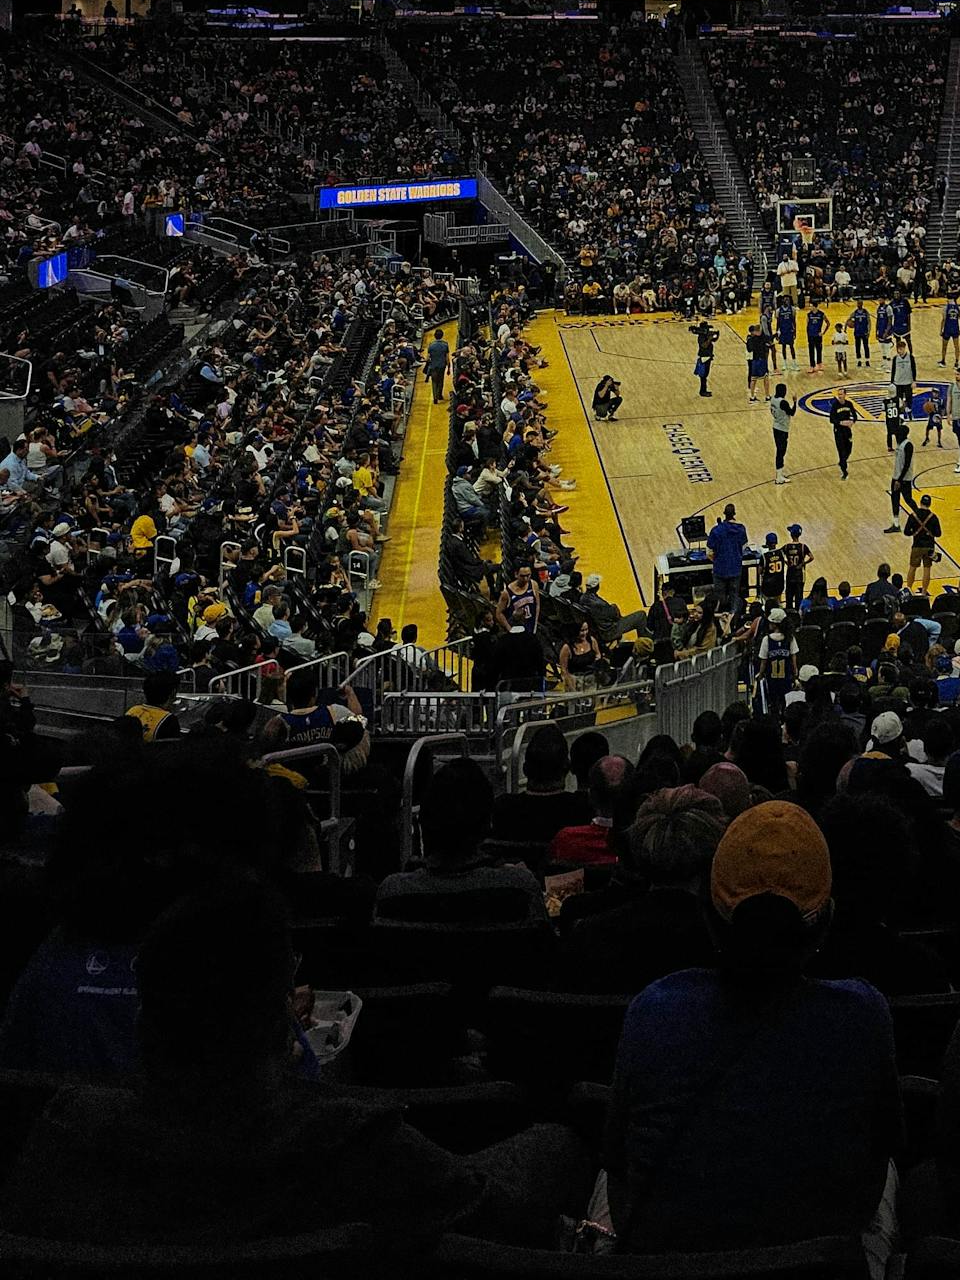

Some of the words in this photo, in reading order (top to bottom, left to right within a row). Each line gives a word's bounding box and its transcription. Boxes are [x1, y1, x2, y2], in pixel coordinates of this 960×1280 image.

[337, 189, 377, 204] GOLDEN
[378, 187, 407, 201] STATE
[407, 183, 461, 199] WARRIORS
[886, 407, 898, 418] 30
[662, 423, 693, 447] CHASE
[679, 456, 713, 484] CENTER
[768, 564, 783, 574] 30
[770, 658, 786, 679] 11
